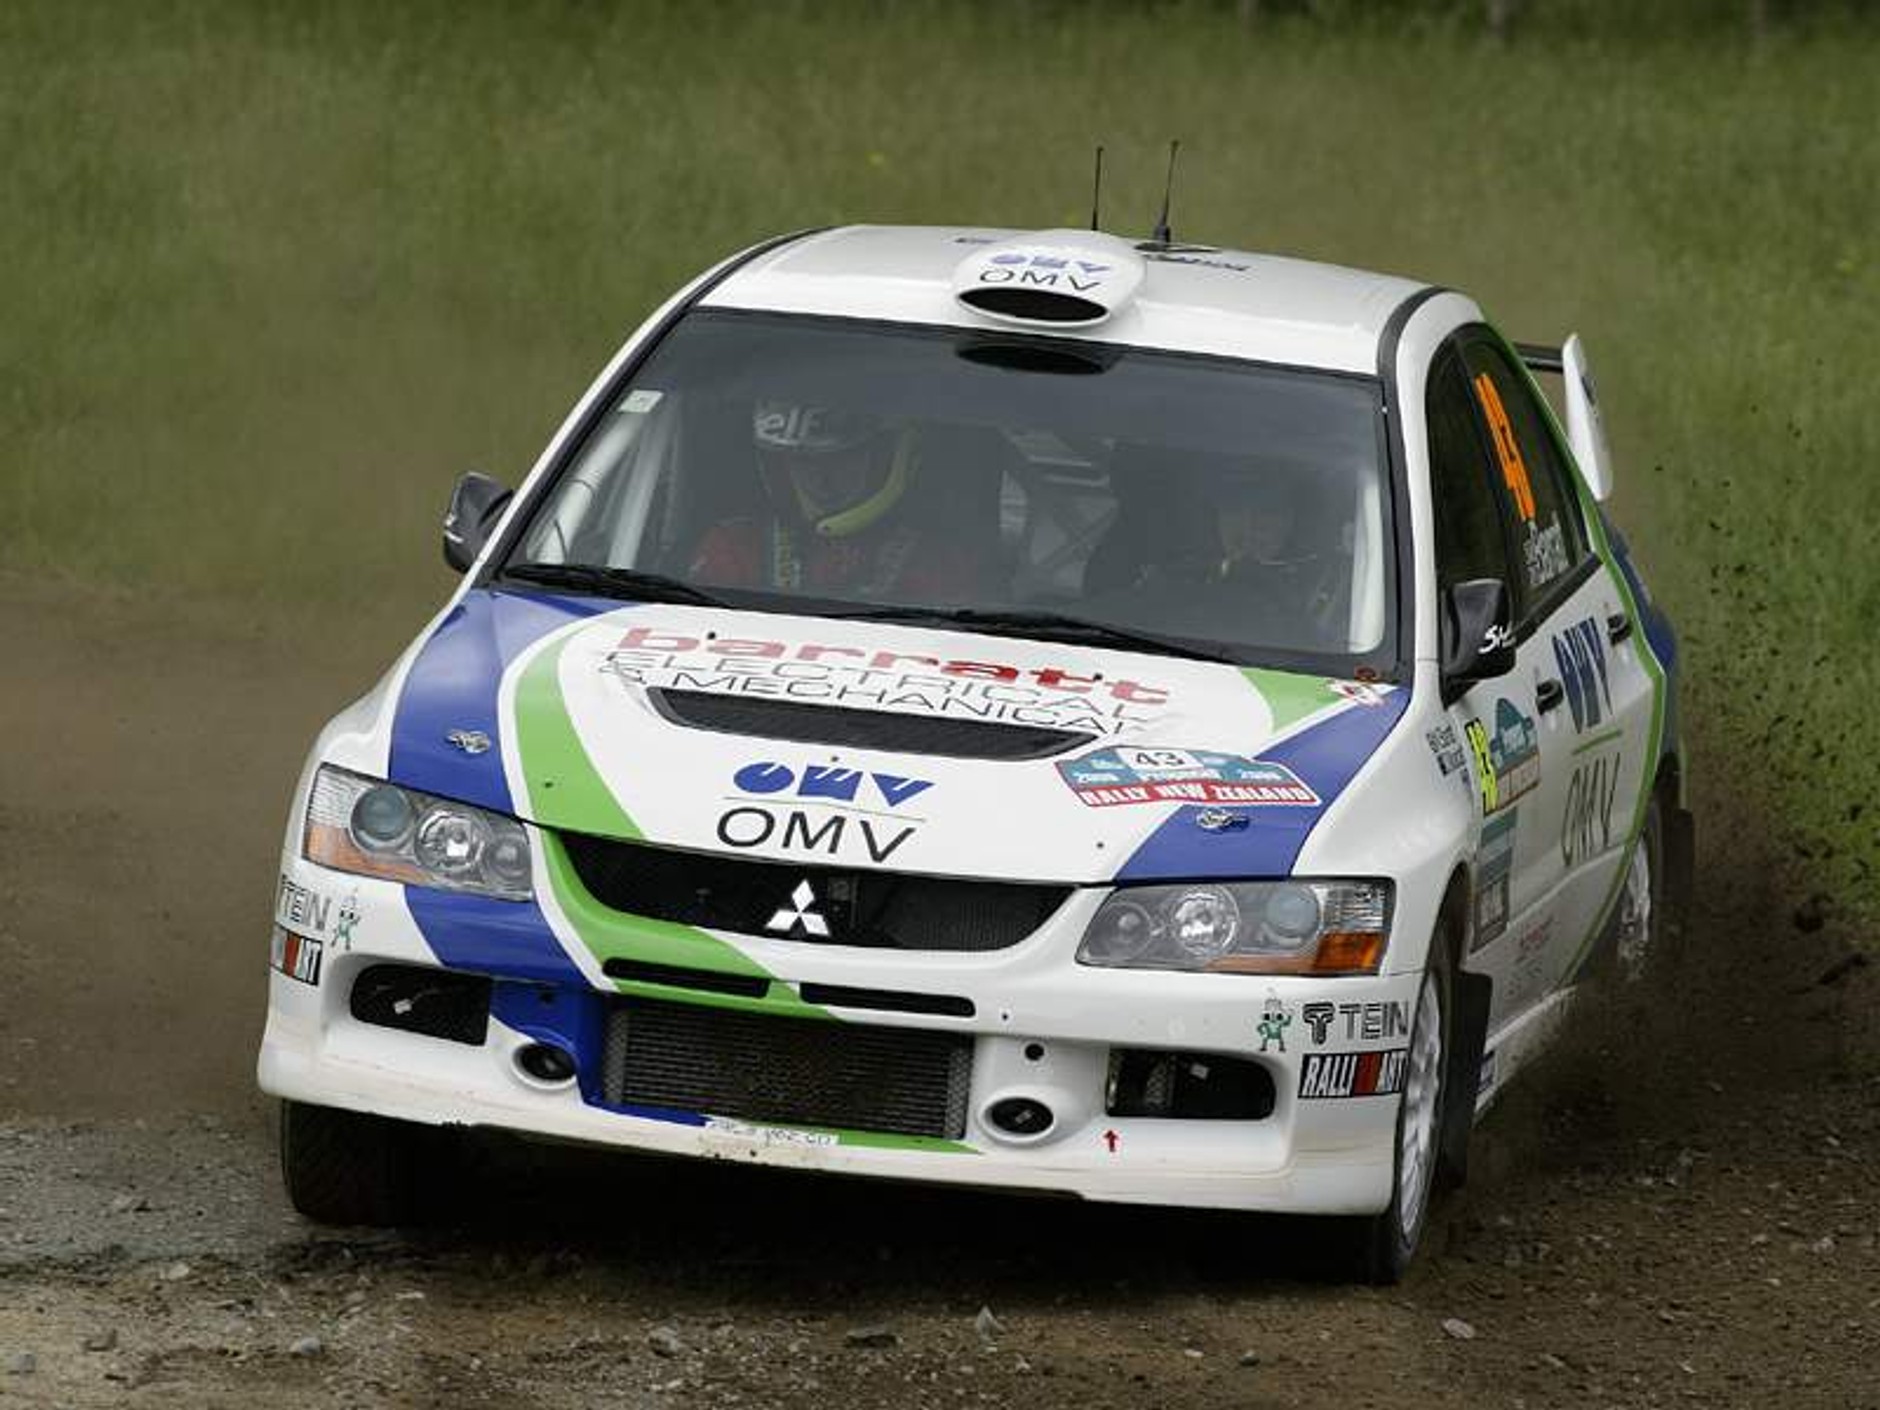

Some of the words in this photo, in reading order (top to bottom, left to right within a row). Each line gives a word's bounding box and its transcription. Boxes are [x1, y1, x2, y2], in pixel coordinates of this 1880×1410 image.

[980, 269, 1101, 291] OMV
[617, 627, 1169, 705] barratt
[605, 650, 1160, 723] ELECTRICAL
[1135, 751, 1186, 769] 43
[1080, 787, 1149, 806] RALLY
[1153, 782, 1207, 801] NEW
[1209, 785, 1311, 801] ZEALAND
[716, 806, 917, 864] OMV
[1339, 1000, 1410, 1040] TEIN
